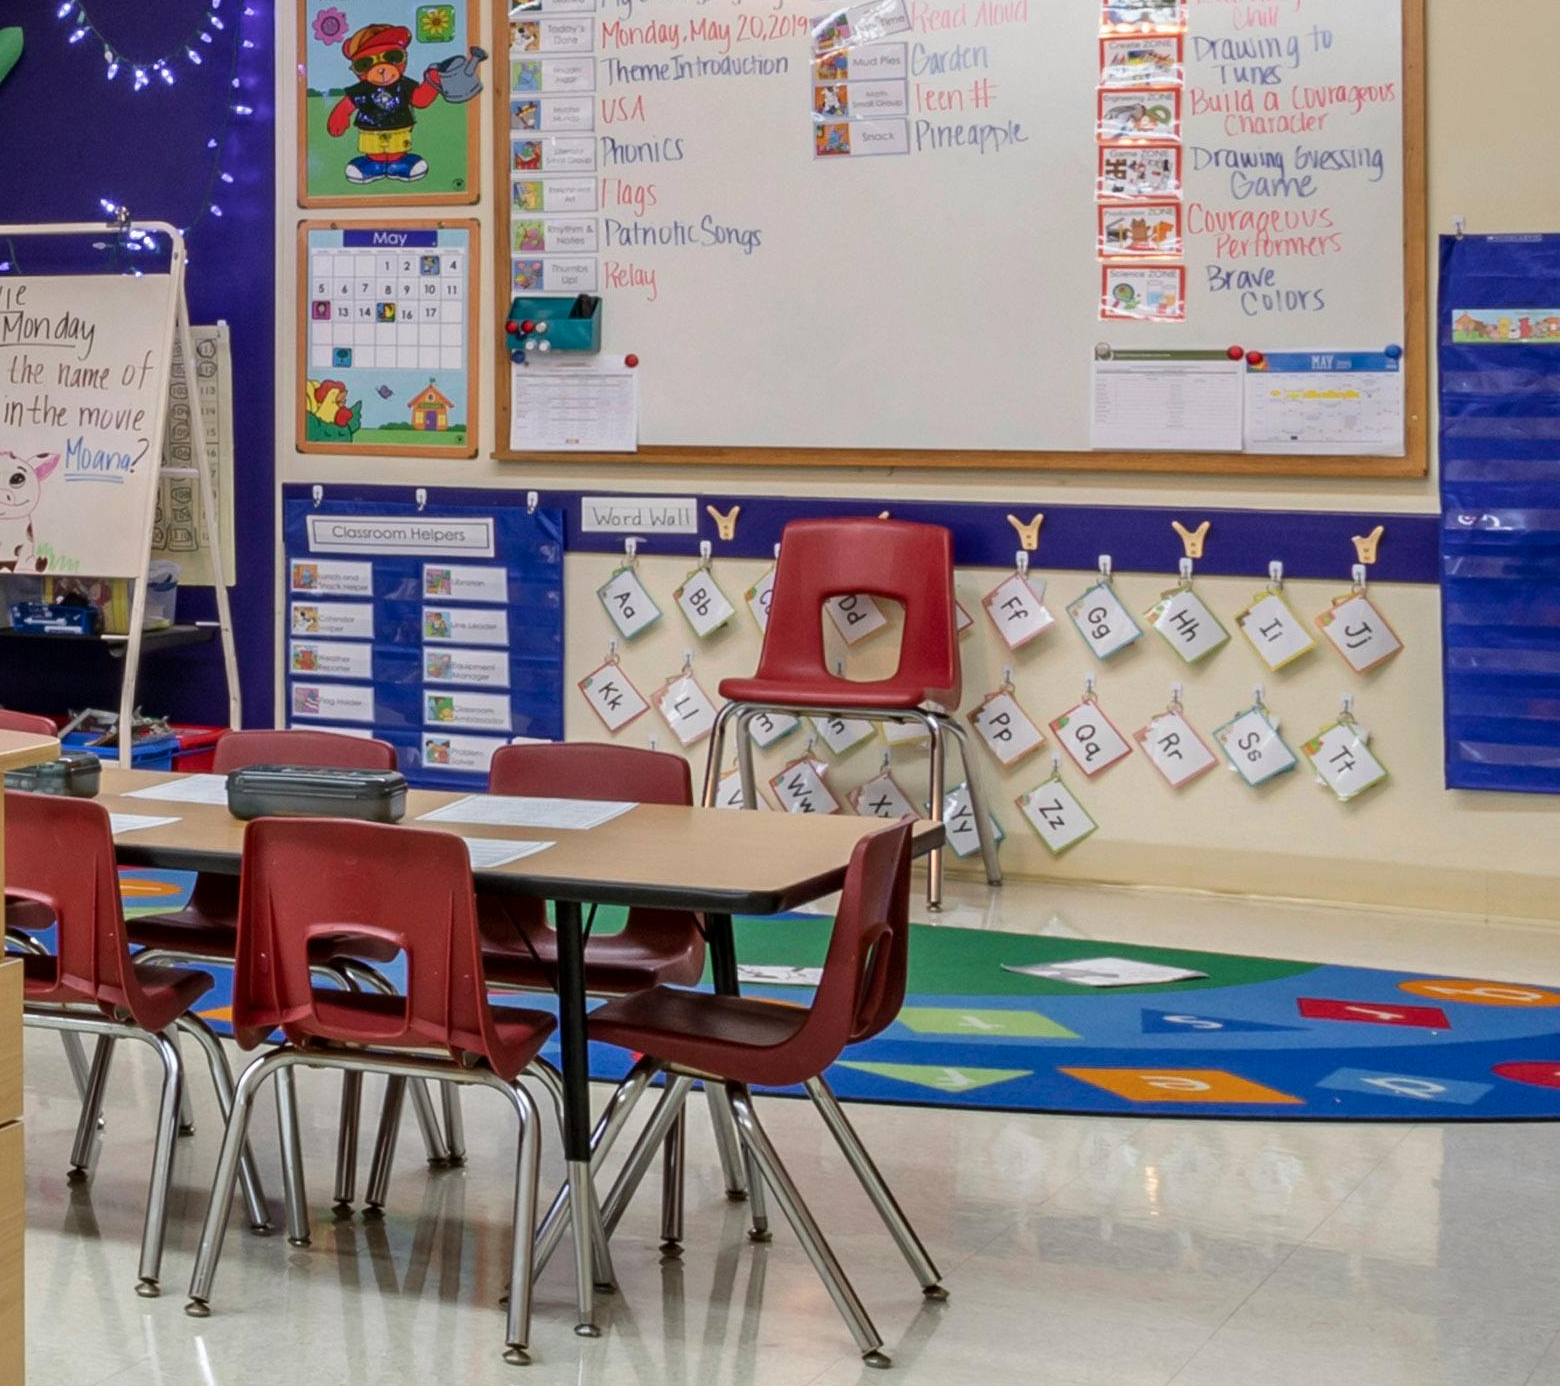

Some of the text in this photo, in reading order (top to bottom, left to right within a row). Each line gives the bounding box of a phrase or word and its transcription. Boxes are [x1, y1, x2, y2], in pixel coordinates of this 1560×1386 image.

[911, 0, 967, 33] Read
[602, 19, 689, 50] Monday,
[690, 17, 732, 54] May
[1193, 24, 1333, 69] Drawing to
[602, 56, 669, 87] Theme
[670, 53, 789, 83] Introduction
[911, 42, 989, 77] Garden
[1217, 63, 1283, 85] Tunes
[601, 95, 647, 124] USA
[915, 82, 965, 112] Teen
[1190, 82, 1396, 116] Build a Courageous
[914, 119, 1029, 155] Pineapple
[1223, 111, 1328, 137] Character
[600, 136, 685, 168] Phonics
[1190, 144, 1384, 182] Drawing Guessing
[1229, 171, 1318, 200] Game
[603, 214, 763, 256] Patriotic Songs
[1186, 202, 1334, 237] Courageous
[372, 231, 408, 247] May
[1215, 232, 1343, 260] Performers
[384, 261, 457, 271] 1 2 4
[1206, 264, 1277, 293] Brave
[318, 283, 458, 295] 5 6 7 8 9 10 11
[603, 261, 658, 303] Relay
[337, 307, 437, 320] 13 14 16 17
[1240, 287, 1326, 316] Colors
[1, 310, 96, 361] Monday
[9, 354, 44, 386] the
[57, 359, 110, 390] name
[120, 348, 155, 391] of
[1311, 354, 1334, 370] MAY
[3, 399, 24, 426] in
[26, 394, 69, 427] the
[78, 404, 146, 433] movie
[592, 506, 692, 527] Word Wall
[331, 524, 466, 544] Classroom Helpers
[613, 590, 636, 621] Aa
[687, 586, 710, 617] Bb
[838, 594, 866, 626] Dd
[999, 596, 1029, 623] Ff
[1087, 606, 1112, 638] Gg
[1168, 609, 1198, 643] Hh
[1258, 617, 1283, 643] Ii
[1343, 621, 1373, 650] Jj
[598, 681, 624, 712] Kk
[988, 712, 1014, 743] Pp
[1073, 723, 1102, 763] Qq
[1157, 731, 1184, 763] Rr
[1237, 731, 1263, 763] Ss
[1328, 745, 1356, 775] Tt
[1038, 797, 1066, 831] Zz
